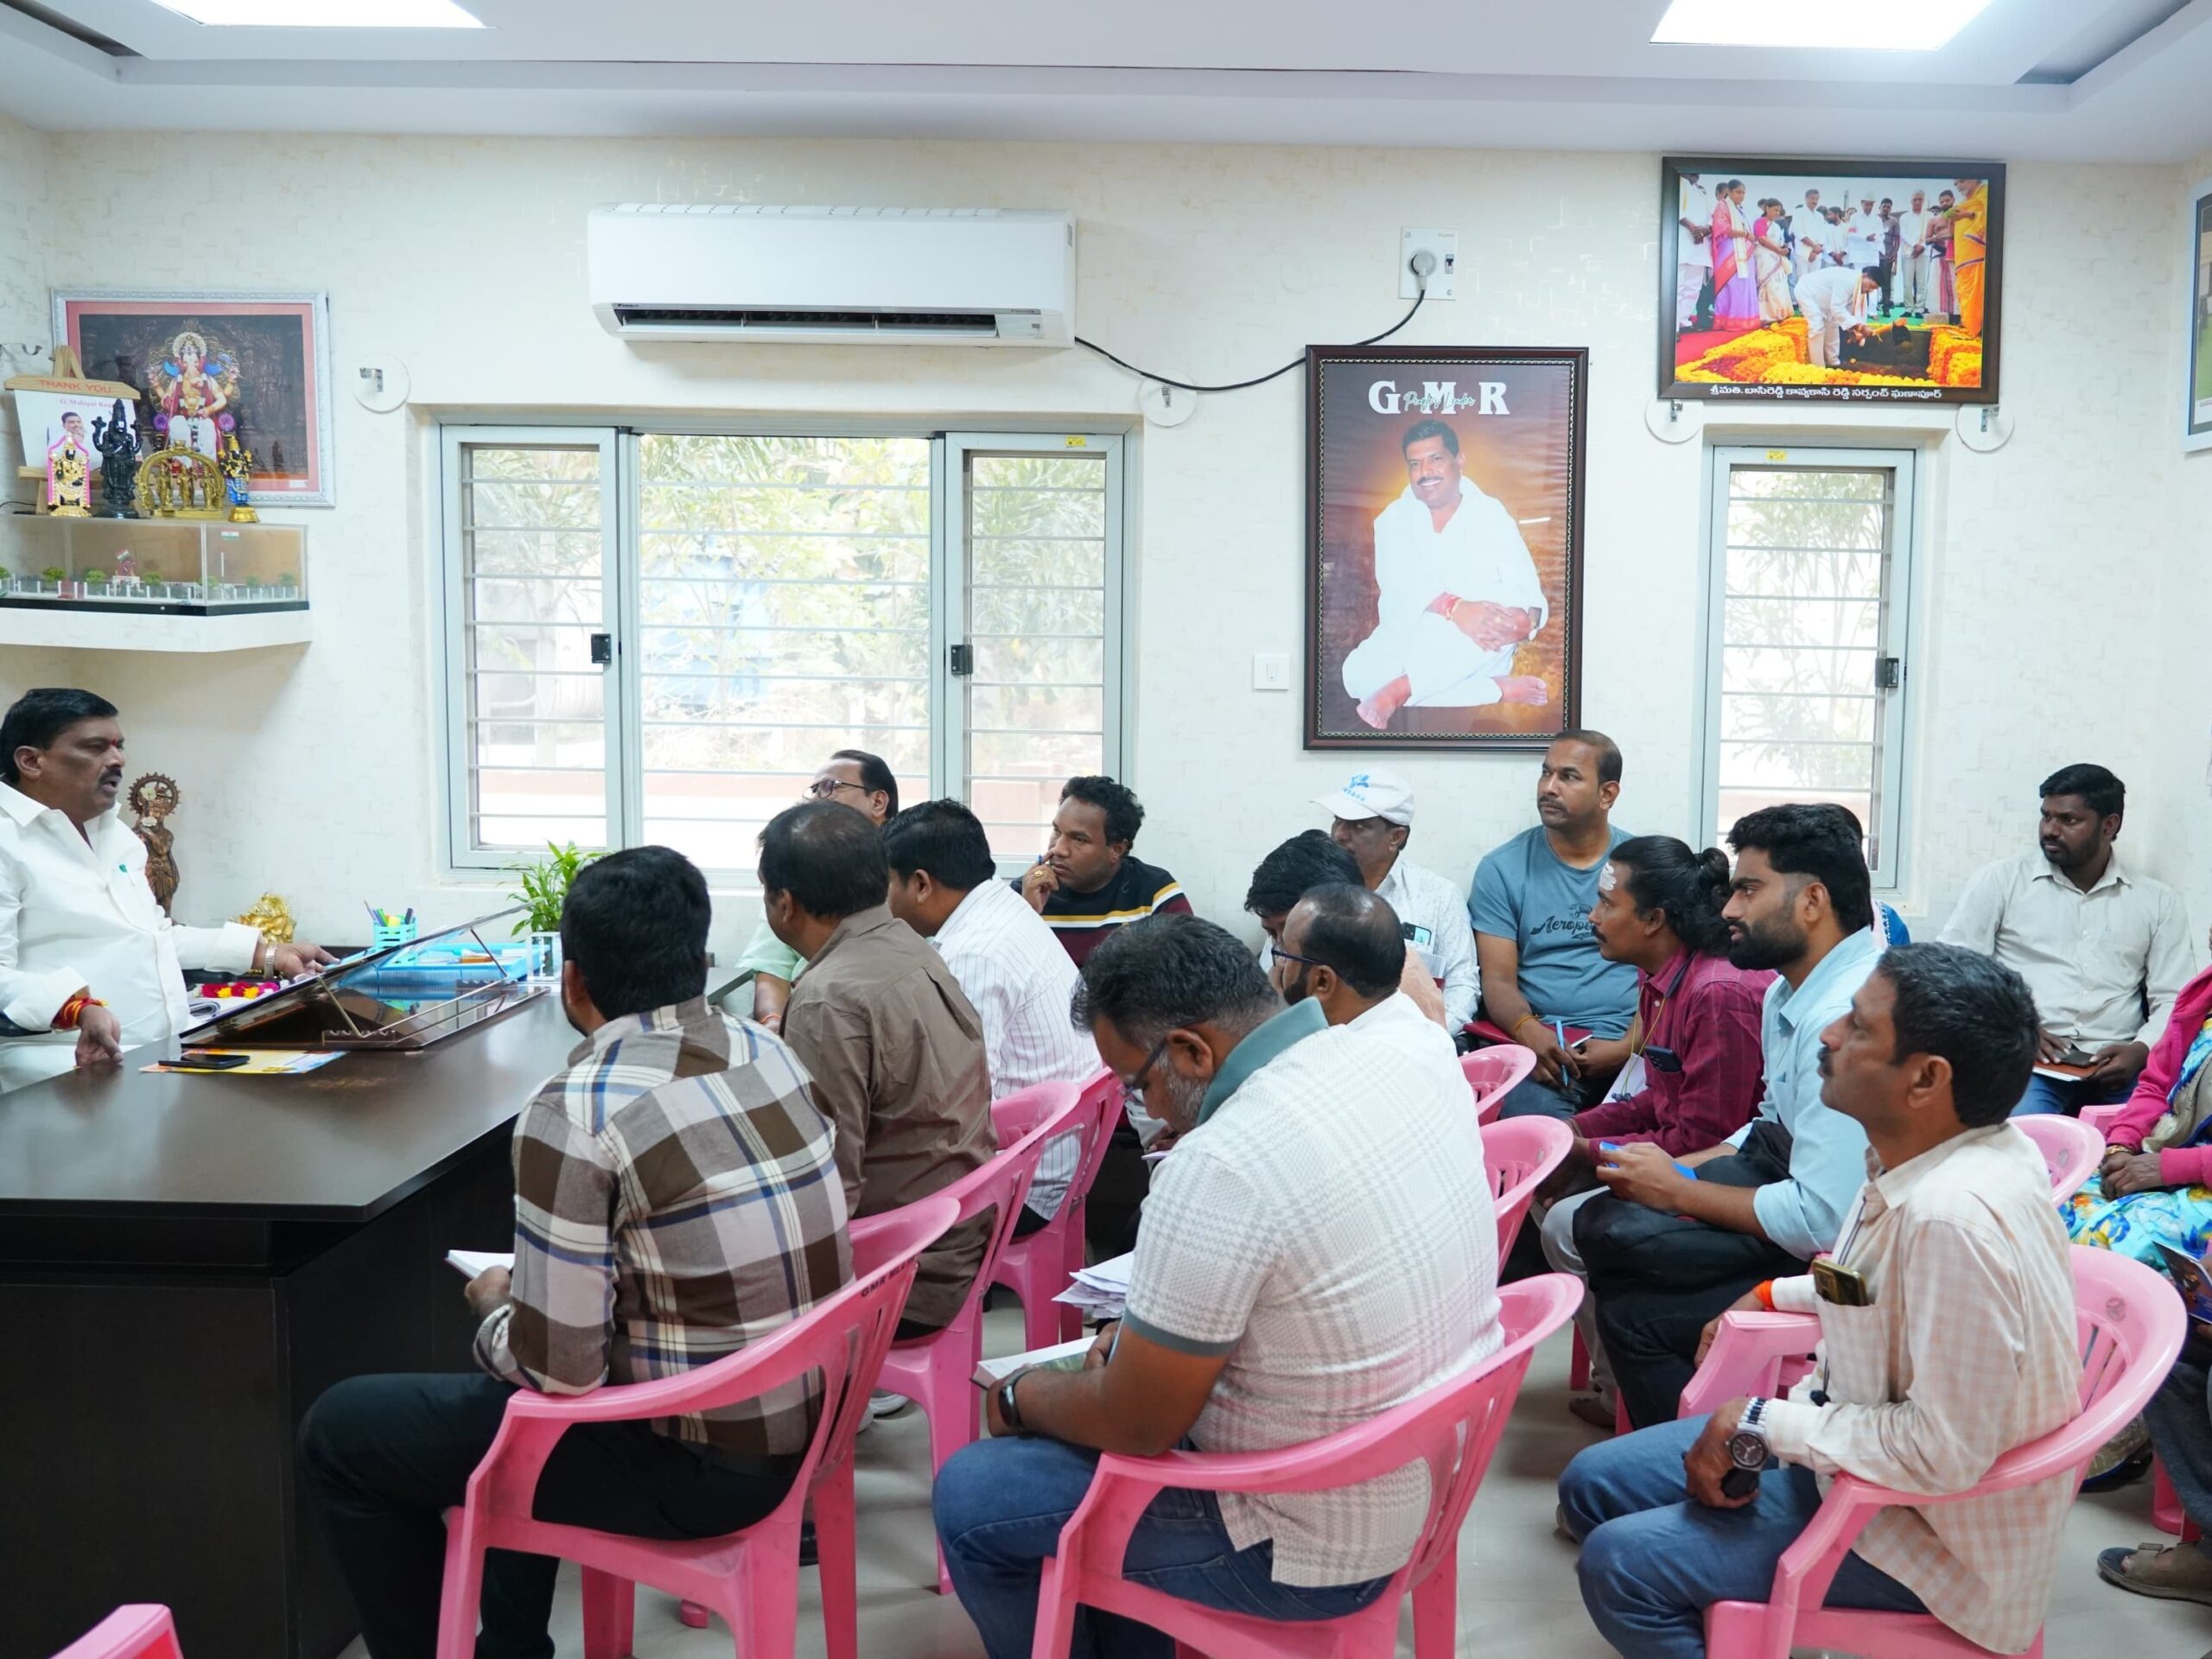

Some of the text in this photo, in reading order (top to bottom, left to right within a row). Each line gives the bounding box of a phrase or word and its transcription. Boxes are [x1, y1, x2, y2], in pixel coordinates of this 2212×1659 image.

[39, 378, 111, 393] THANK YOU
[1368, 380, 1402, 415] G
[1478, 382, 1510, 415] R
